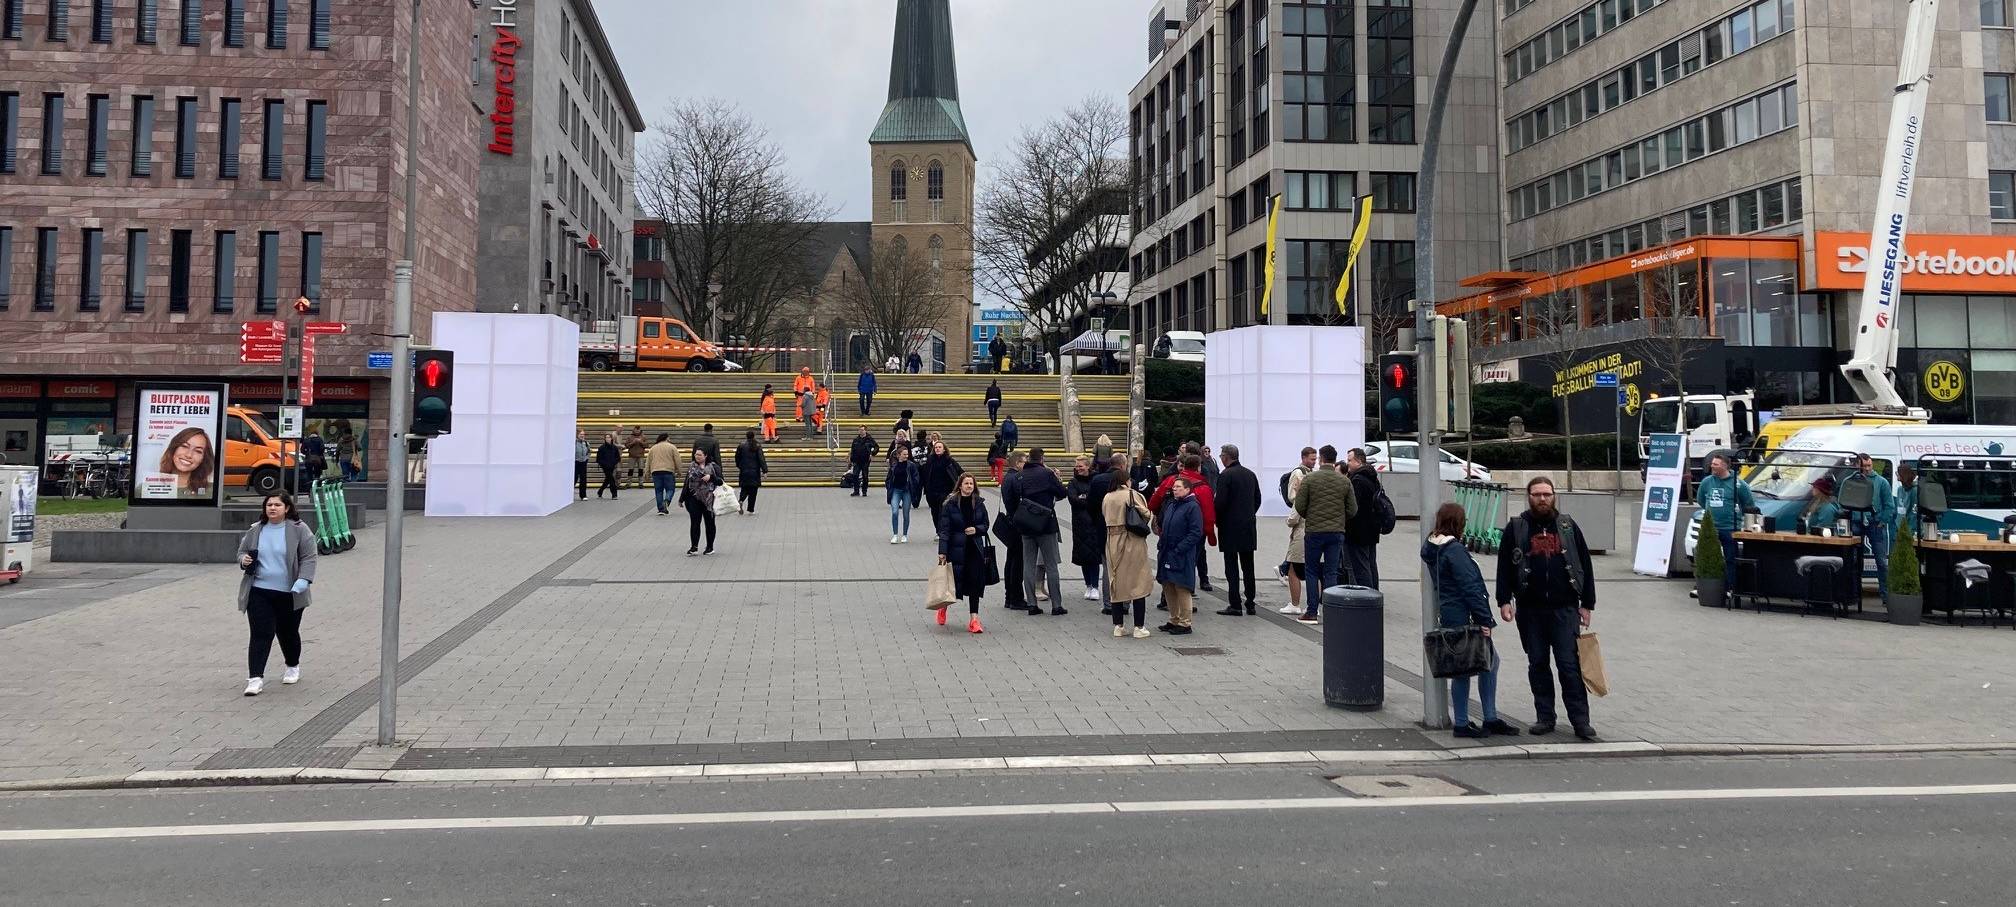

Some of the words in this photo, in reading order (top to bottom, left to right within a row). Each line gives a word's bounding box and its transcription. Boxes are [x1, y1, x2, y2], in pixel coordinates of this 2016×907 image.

[488, 0, 522, 155] IntercityH
[1879, 213, 1903, 306] LIESEGANG
[1895, 115, 1918, 199] liftverleih.de
[1902, 248, 2016, 276] otebook
[1556, 360, 1598, 382] WILKOMMEN
[1599, 358, 1607, 370] IN
[1607, 353, 1622, 368] DER
[1930, 366, 1959, 389] BVB
[64, 384, 100, 394] comic
[232, 383, 284, 395] schaurau
[321, 385, 355, 396] comic
[1939, 388, 1951, 398] 09
[150, 394, 211, 404] BLUTPLASMA
[150, 405, 181, 415] RETTET
[184, 405, 210, 415] LEBEN
[1904, 443, 1940, 454] meet
[1943, 443, 1953, 454] &
